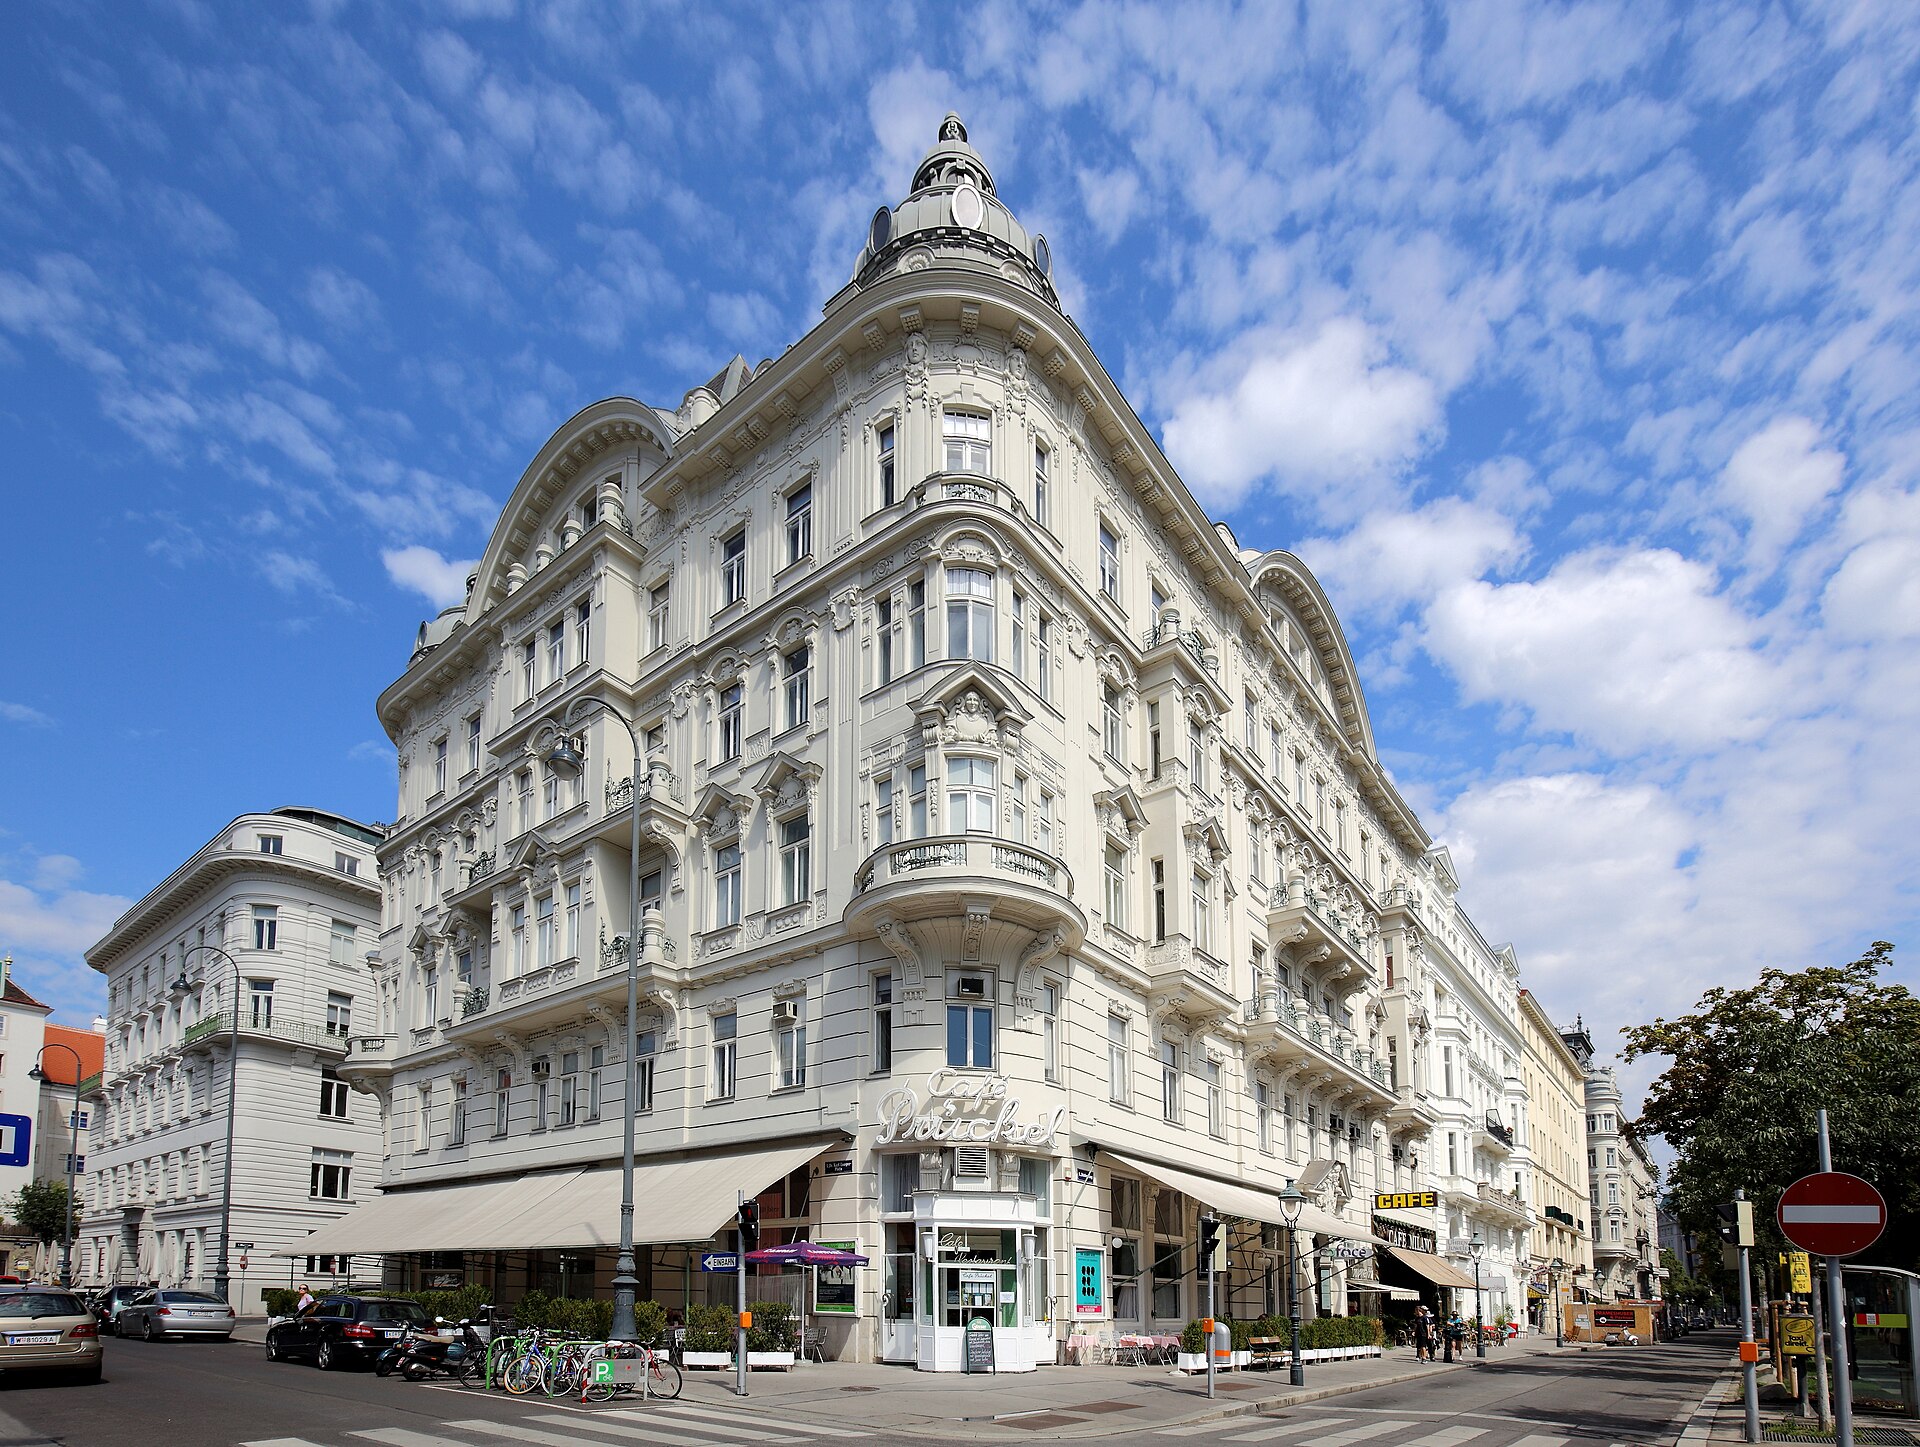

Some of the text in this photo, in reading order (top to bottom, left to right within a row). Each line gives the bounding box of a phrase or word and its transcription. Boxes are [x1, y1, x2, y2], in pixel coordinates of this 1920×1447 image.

[927, 1068, 1011, 1111] Café
[876, 1088, 1067, 1149] Prückel
[1377, 1192, 1435, 1209] CAFE
[1408, 1234, 1433, 1254] MILANO
[713, 1257, 736, 1267] EINBAHN
[595, 1363, 610, 1382] P
